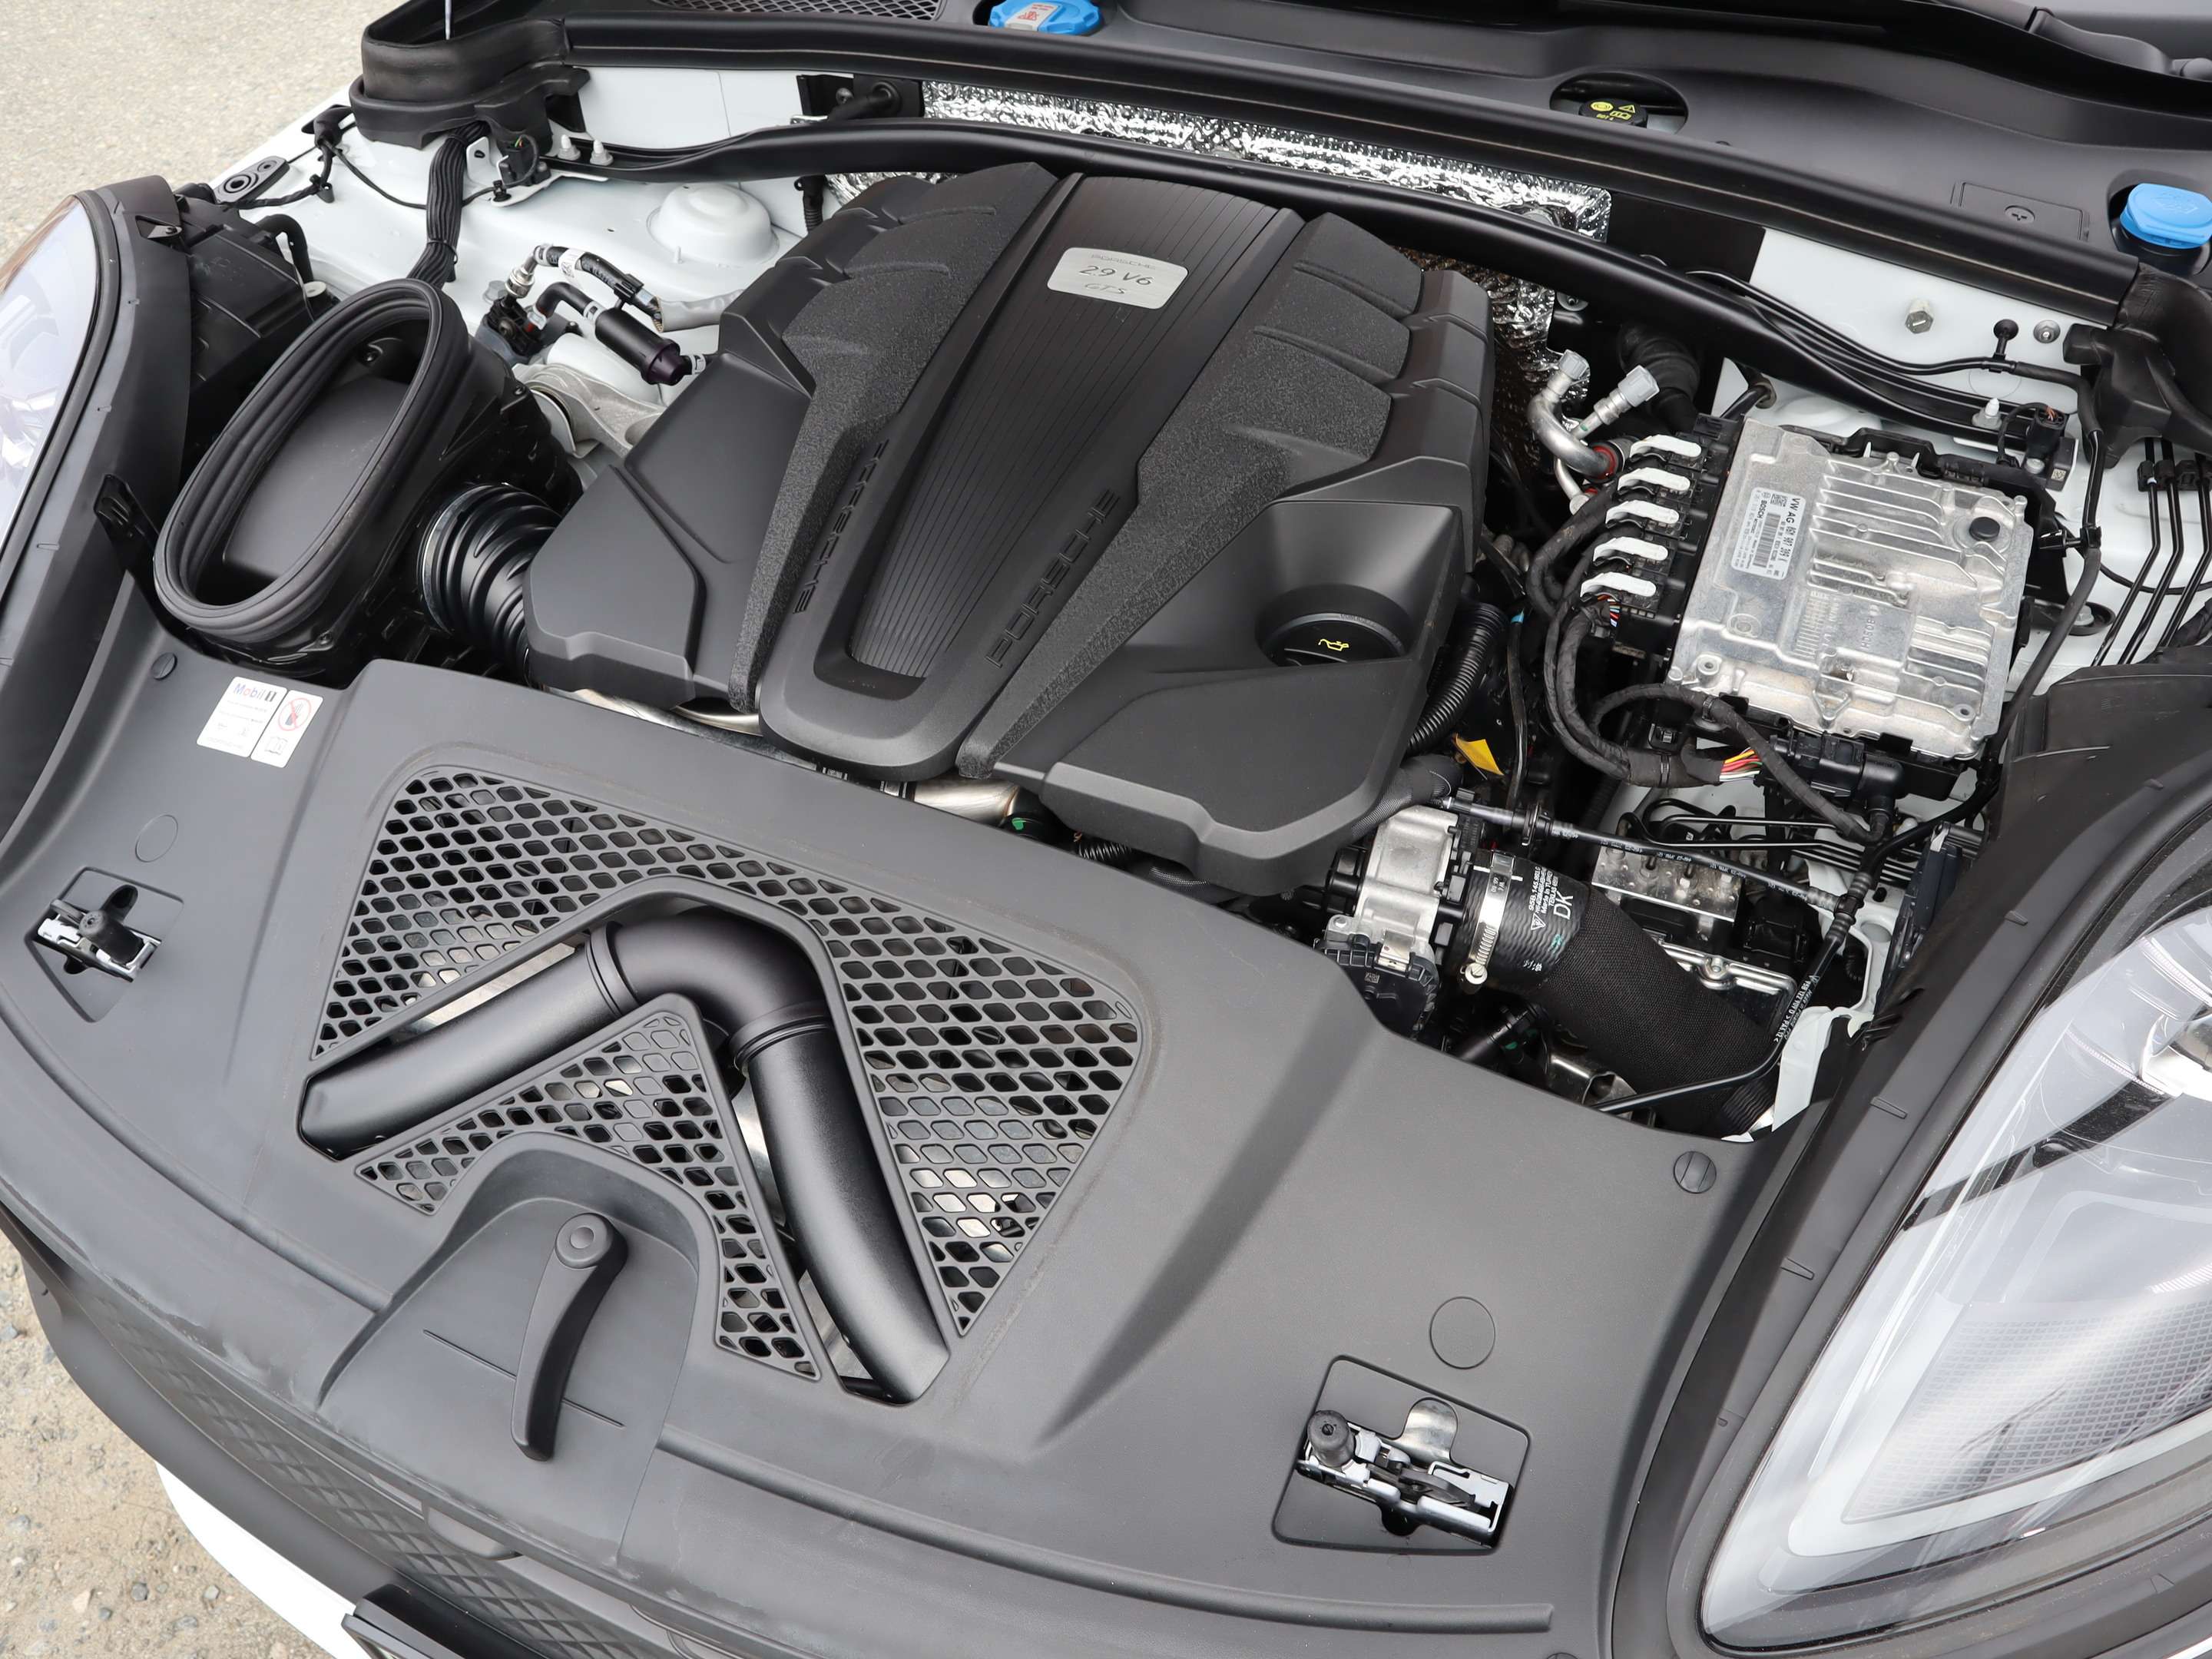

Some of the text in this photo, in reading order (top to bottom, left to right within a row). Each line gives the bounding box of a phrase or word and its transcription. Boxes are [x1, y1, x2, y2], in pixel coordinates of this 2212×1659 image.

[1079, 265, 1153, 286] 2.9 V6
[1084, 283, 1128, 295] GTS
[1757, 499, 1767, 518] BOSCH
[794, 438, 890, 614] PORSCHE
[984, 488, 1121, 668] PORSCHE
[1860, 618, 1876, 651] BOSCH
[233, 683, 265, 700] Mobil
[1553, 890, 1574, 920] DK
